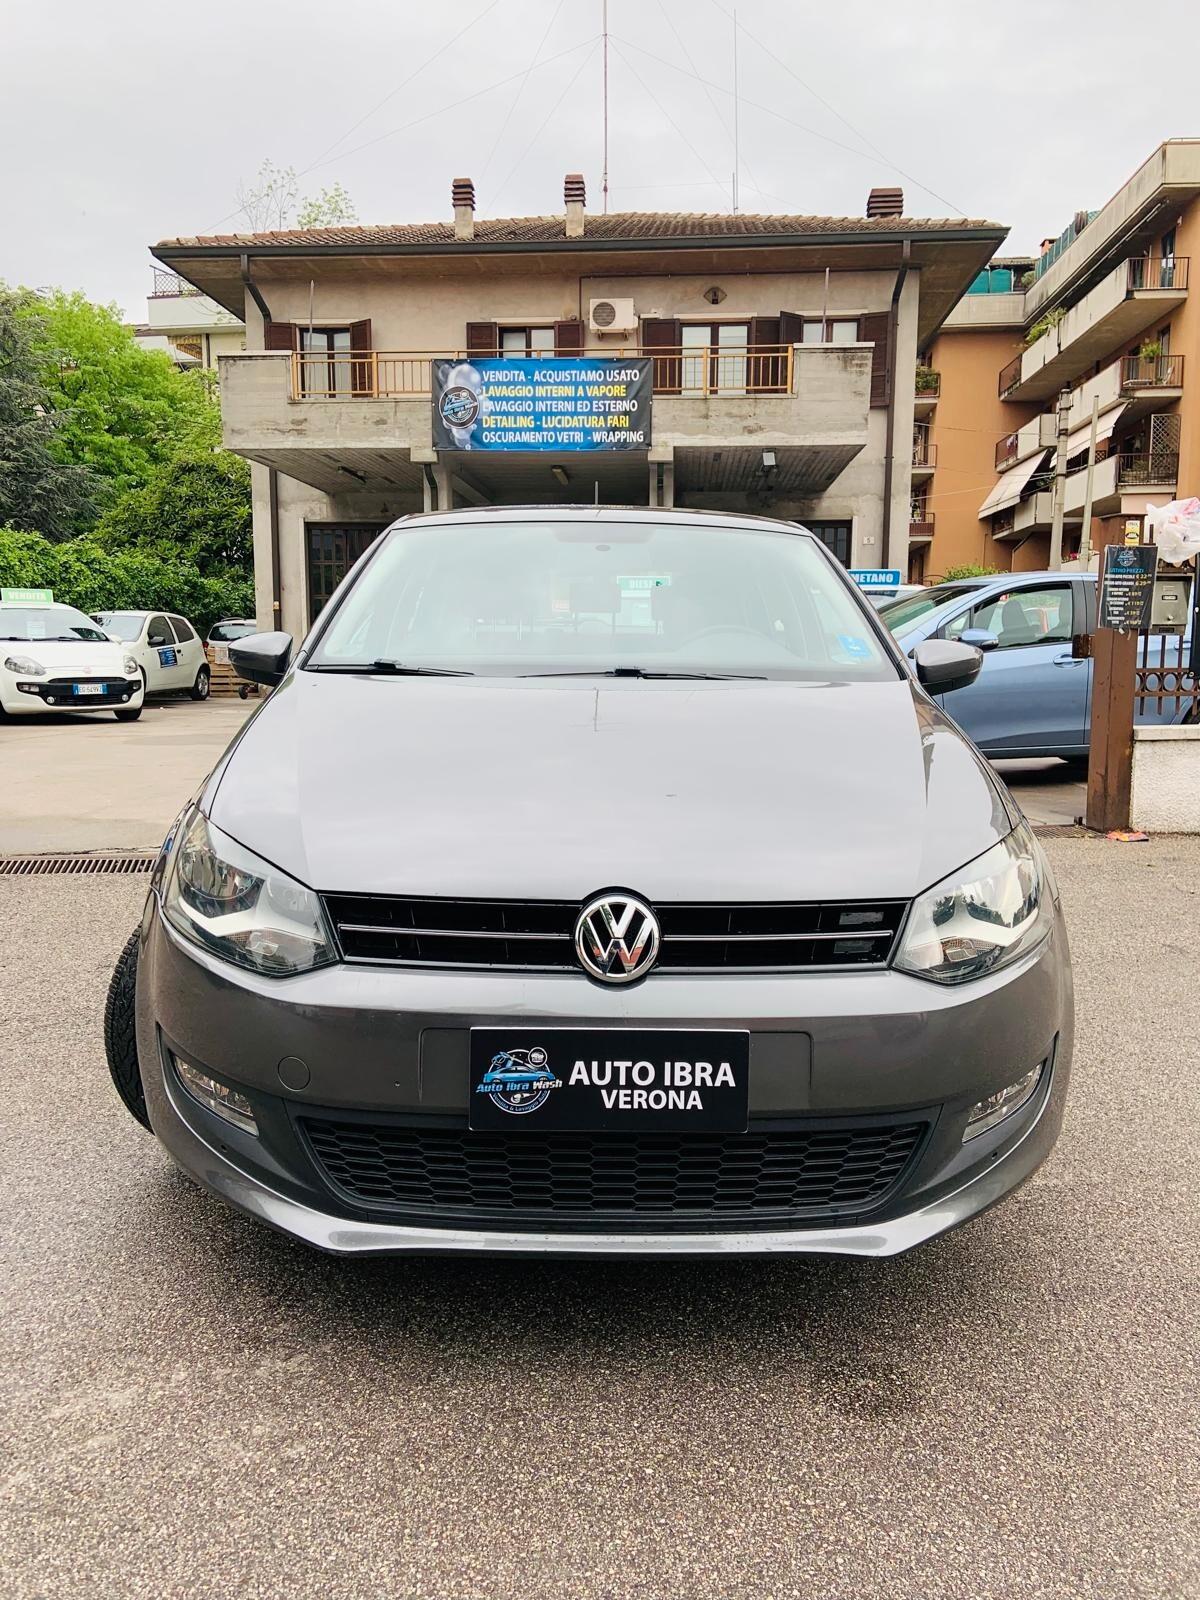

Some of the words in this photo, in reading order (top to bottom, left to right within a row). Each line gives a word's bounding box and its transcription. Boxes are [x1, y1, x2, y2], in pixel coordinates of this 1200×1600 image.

[483, 370, 525, 382] VENDITA
[533, 370, 605, 384] ACQUISTIAMO
[606, 369, 640, 382] USATO
[482, 385, 533, 397] LAVAGGIO
[535, 385, 575, 397] INTERNI
[577, 385, 584, 397] A
[585, 385, 627, 397] VAPORE
[482, 400, 533, 412] LAVAGGIO
[535, 400, 575, 412] INTERNI
[577, 400, 590, 412] ED
[592, 399, 639, 412] ESTERNO
[482, 415, 535, 428] DETAILING
[542, 415, 606, 428] LUCIDATURA
[607, 415, 629, 428] FARI
[482, 431, 555, 443] OSCURAMENTO
[556, 431, 584, 442] VETRI
[592, 430, 644, 443] WRAPPING
[568, 1060, 656, 1087] AUTO
[664, 1061, 736, 1087] IBRA
[475, 1083, 503, 1093] Auto
[506, 1081, 530, 1092] Ibra
[532, 1079, 563, 1090] Wash
[600, 1089, 703, 1110] VERONA
